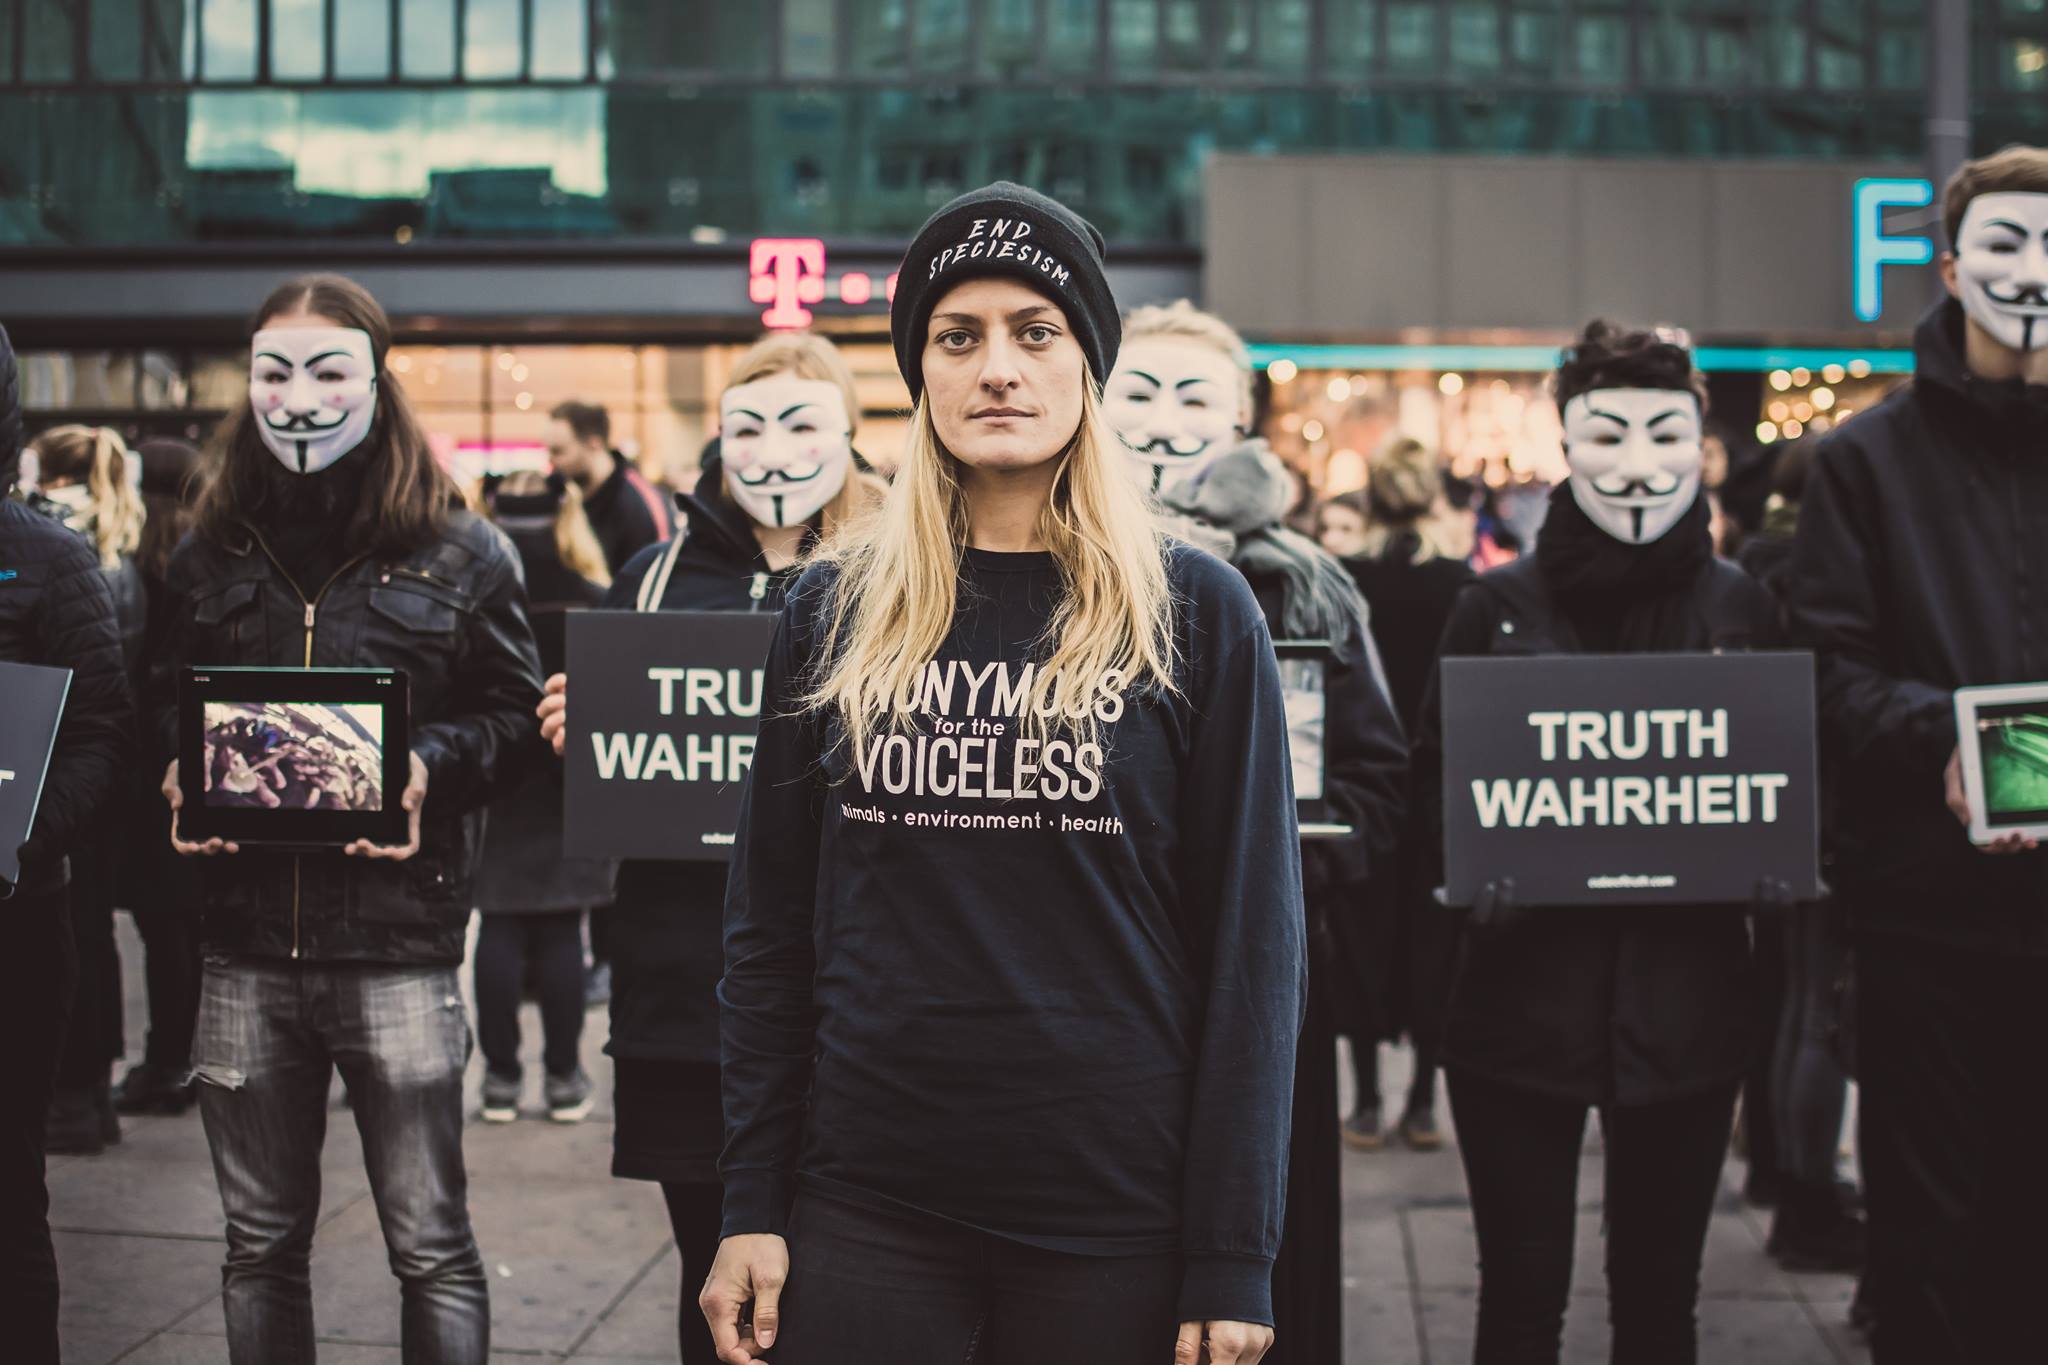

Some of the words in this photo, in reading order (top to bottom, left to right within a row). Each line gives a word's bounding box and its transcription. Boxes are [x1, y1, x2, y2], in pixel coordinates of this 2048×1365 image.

[967, 218, 1032, 240] END
[750, 238, 825, 328] T
[929, 241, 1073, 287] SPECIESISM
[934, 716, 965, 735] for
[971, 717, 1006, 736] the
[1527, 708, 1728, 761] TRUTH
[855, 733, 1104, 802] VOICELESS
[841, 802, 886, 824] nimals
[904, 809, 1041, 830] environment
[1061, 814, 1124, 835] health
[1471, 773, 1789, 828] WAHRHEIT
